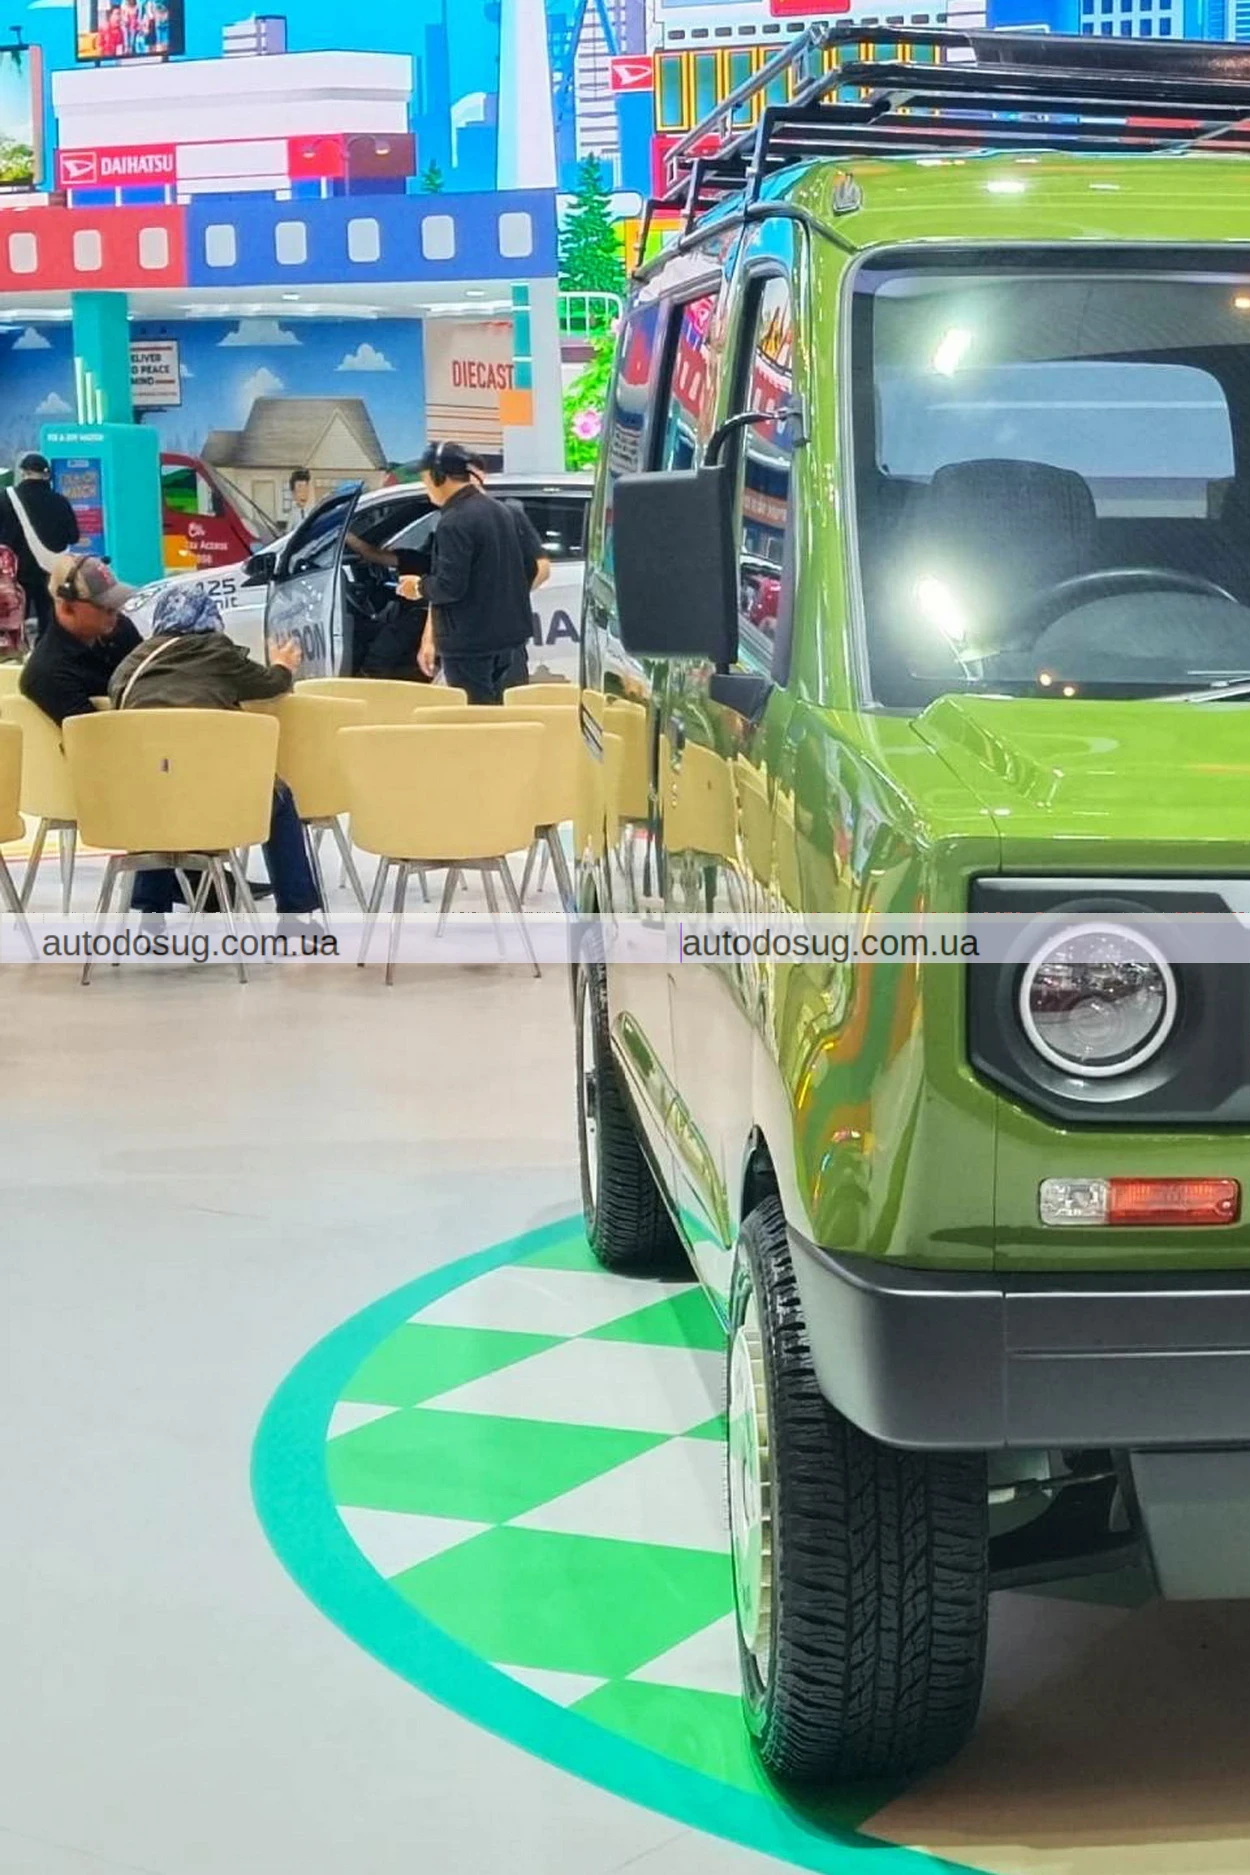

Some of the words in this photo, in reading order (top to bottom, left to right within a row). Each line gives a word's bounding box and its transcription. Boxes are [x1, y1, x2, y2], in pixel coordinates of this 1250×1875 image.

[101, 154, 174, 176] DAIHATSU
[130, 353, 162, 363] ELIVER
[452, 360, 514, 391] DIECAST
[195, 578, 236, 596] 125
